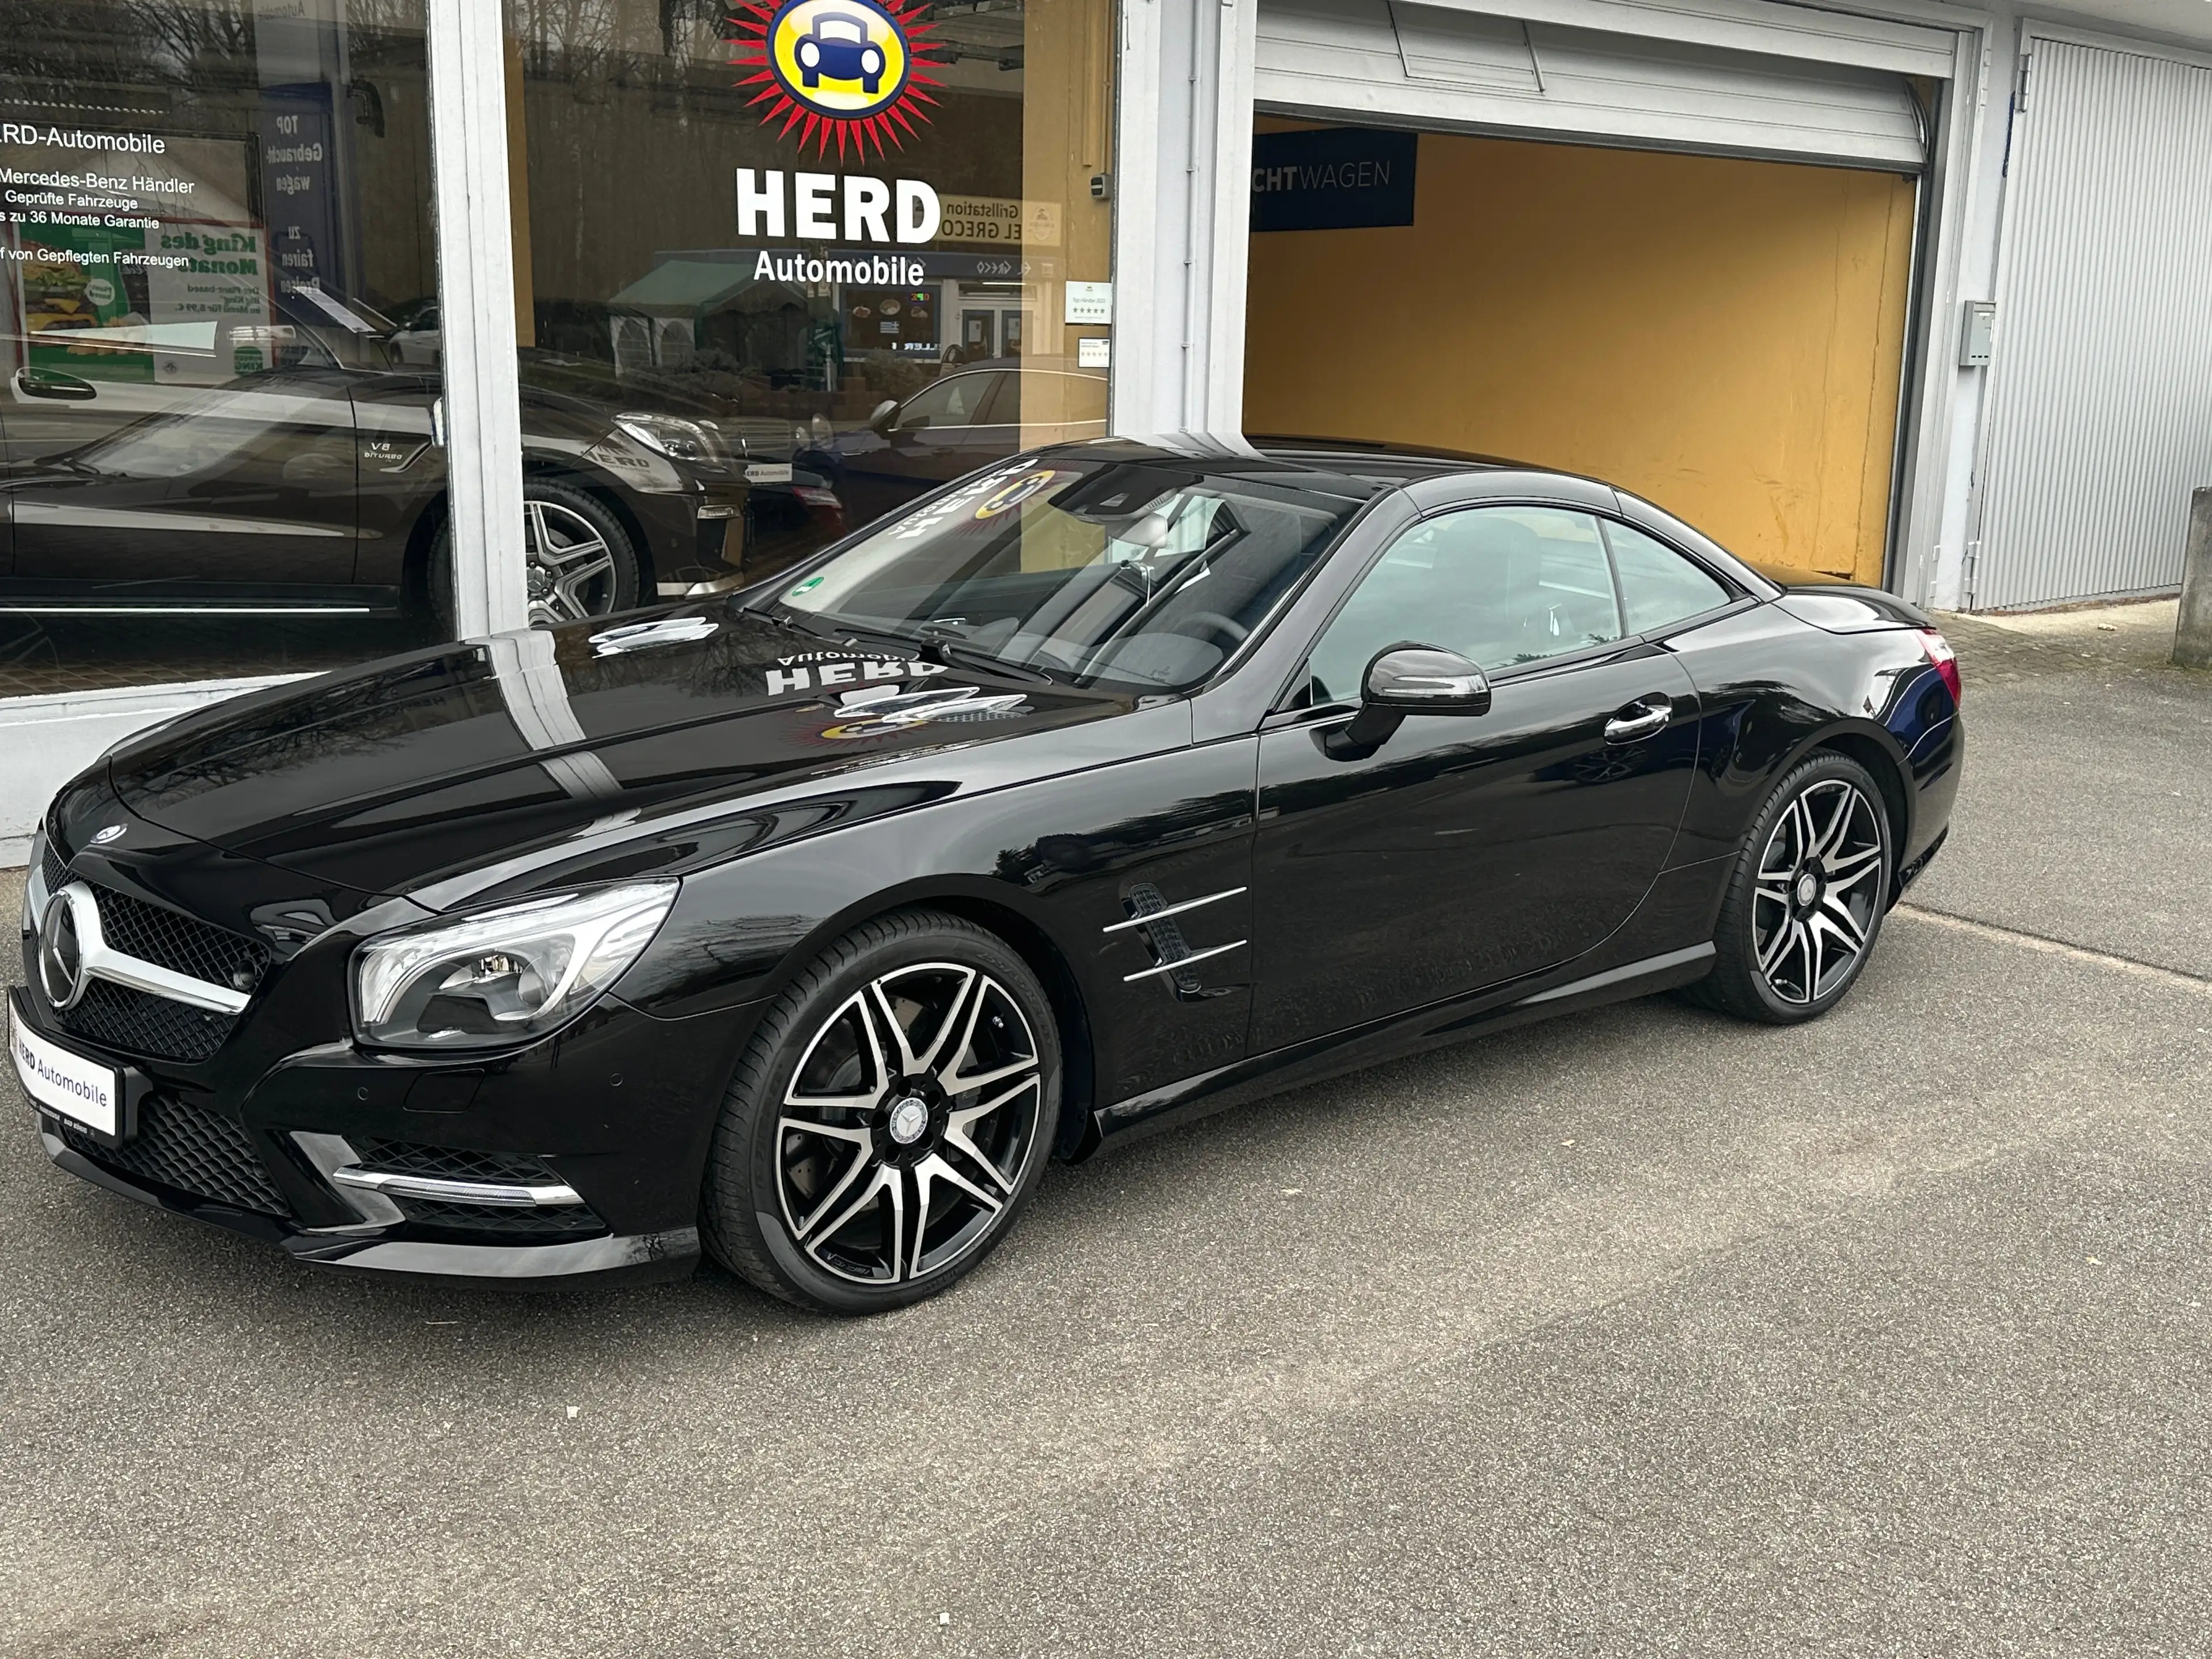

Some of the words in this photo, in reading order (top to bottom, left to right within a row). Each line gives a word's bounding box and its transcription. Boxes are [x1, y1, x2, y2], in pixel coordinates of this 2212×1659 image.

[0, 123, 165, 154] RD-Automobile
[0, 168, 128, 191] Mercedes-Benz
[132, 175, 195, 194] Händler
[5, 190, 64, 206] Geprüfte
[69, 194, 138, 211] Fahrzeuge
[736, 168, 941, 244] HERD
[10, 212, 26, 222] zu
[30, 210, 47, 224] 36
[51, 213, 101, 227] Monate
[104, 214, 160, 229] Garantie
[8, 249, 33, 261] von
[37, 248, 109, 266] Gepflegten
[114, 251, 190, 269] Fahrzeugen
[753, 251, 924, 286] Automobile
[370, 442, 391, 451] V8
[19, 1037, 35, 1070] HERD
[37, 1059, 107, 1107] Automobile
